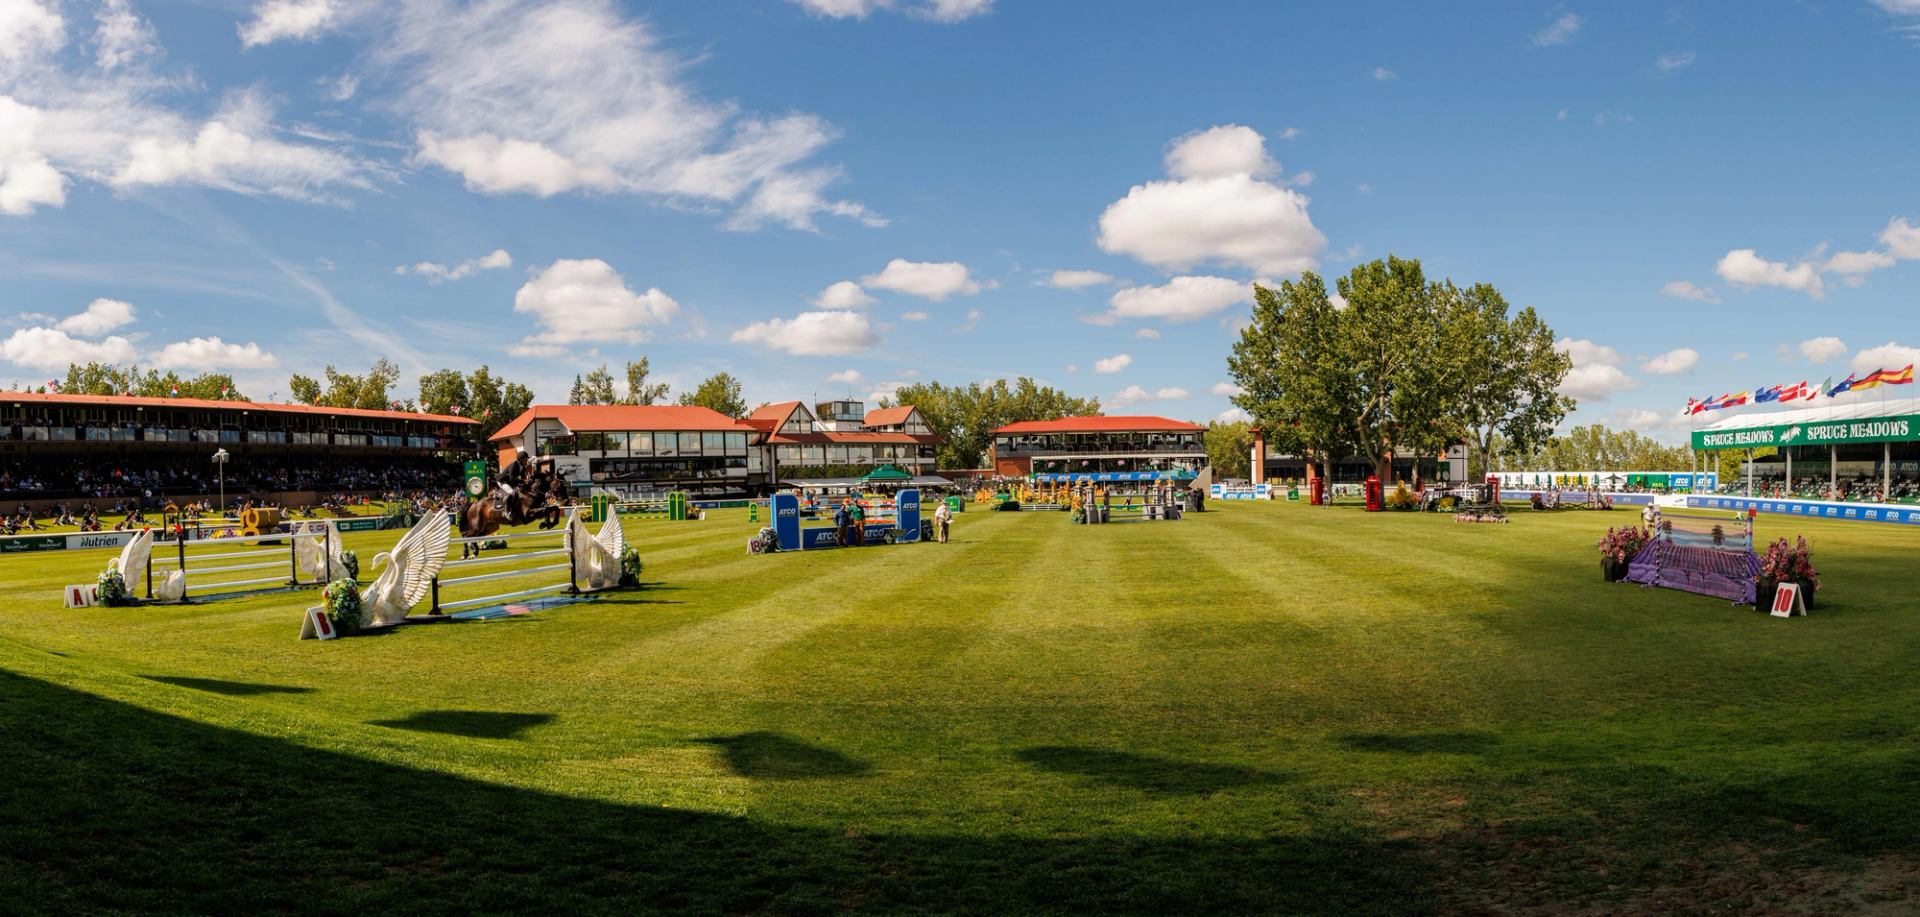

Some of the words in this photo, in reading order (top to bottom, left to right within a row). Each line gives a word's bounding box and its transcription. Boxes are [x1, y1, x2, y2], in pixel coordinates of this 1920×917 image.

[1704, 433, 1734, 446] SPRUCE
[1735, 430, 1774, 445] MEADOWS
[1807, 424, 1847, 441] SPRUCE
[1849, 420, 1909, 438] MEADOWS
[864, 528, 885, 538] ATCO
[80, 536, 118, 547] Nutrien
[750, 541, 760, 553] 18
[73, 589, 84, 606] A
[1774, 588, 1793, 612] 10
[316, 612, 331, 636] B
